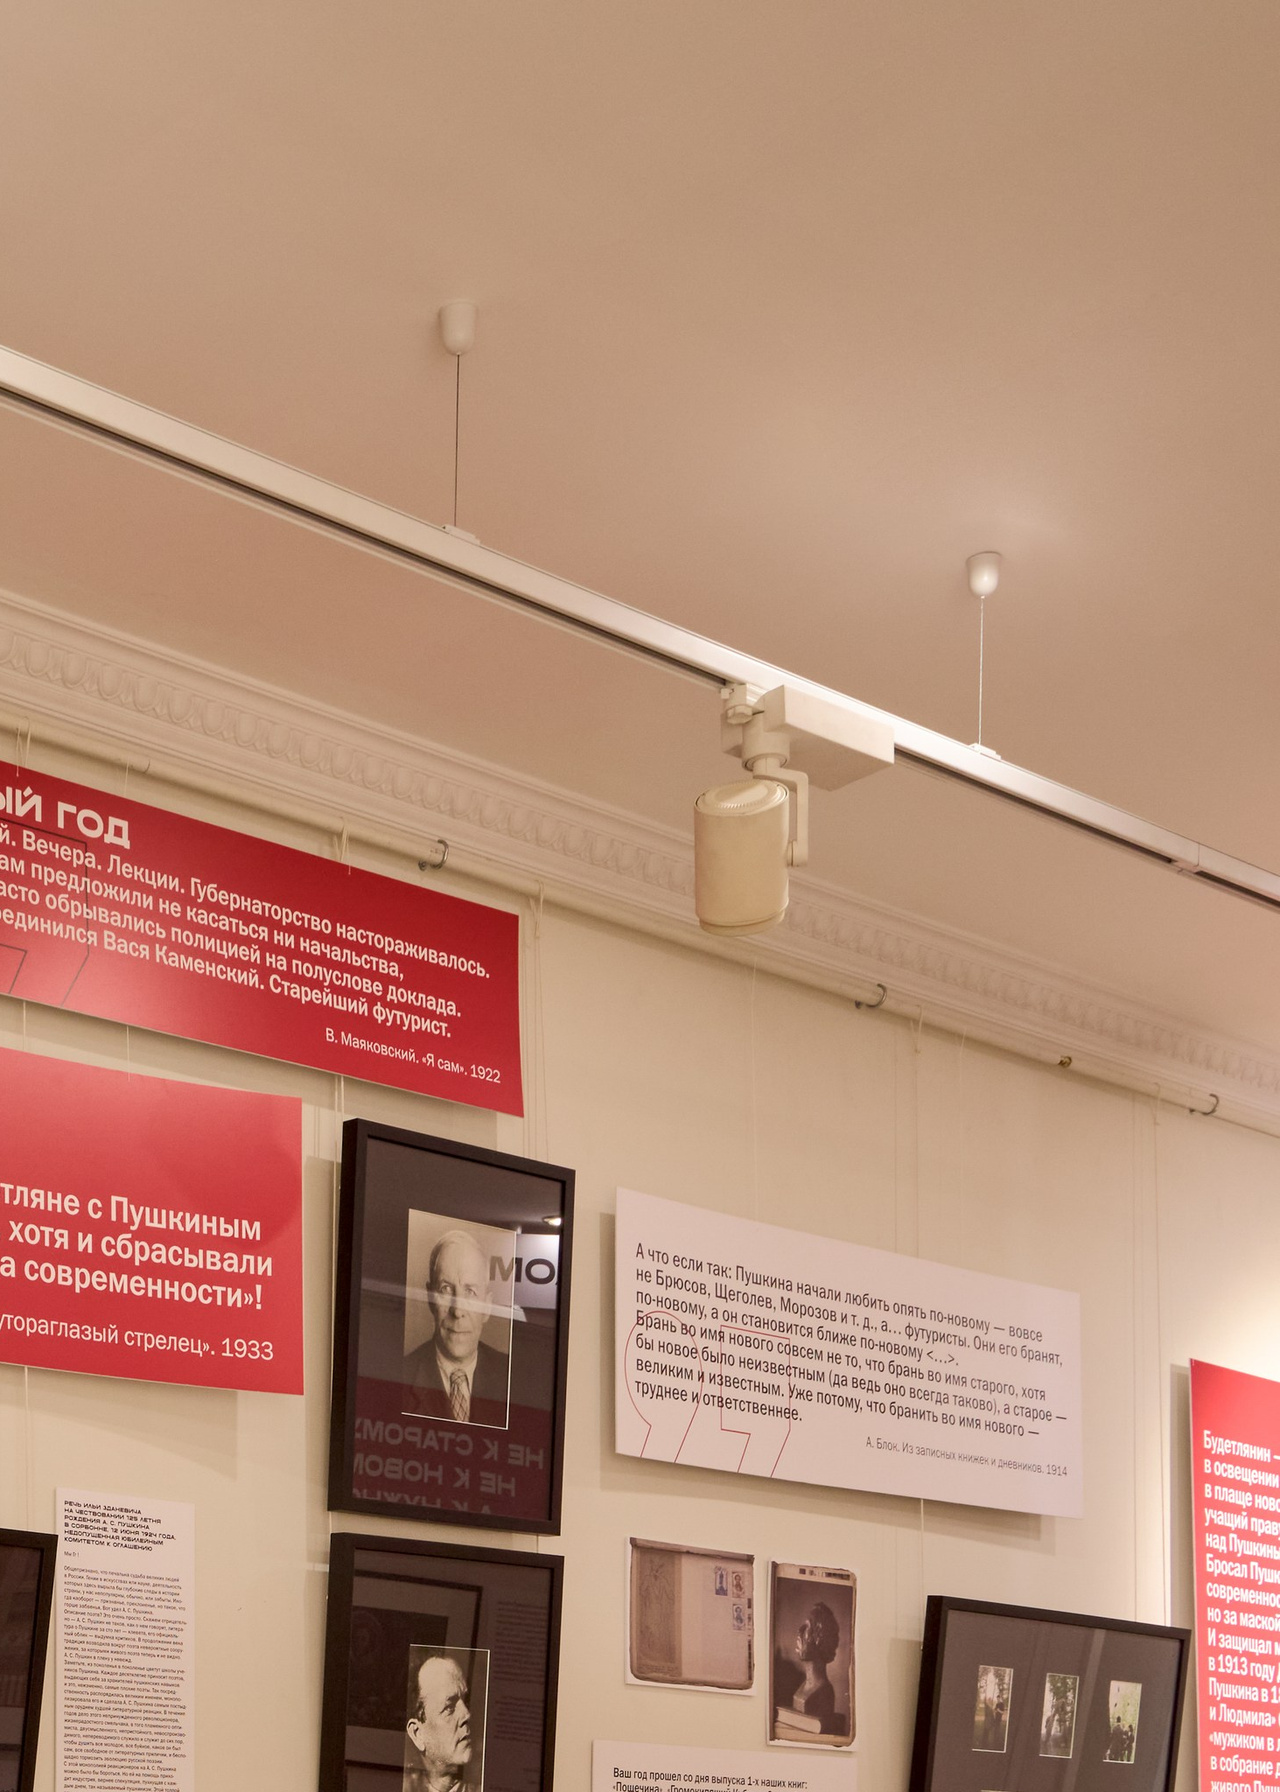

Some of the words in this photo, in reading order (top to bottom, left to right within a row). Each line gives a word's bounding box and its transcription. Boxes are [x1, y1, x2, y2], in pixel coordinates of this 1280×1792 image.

[57, 801, 131, 850] ГОД
[22, 829, 102, 871] Вечера.
[106, 853, 185, 894] Лекции.
[190, 876, 333, 935] Губернаторство
[335, 922, 490, 979] настораживалось.
[103, 929, 150, 961] Вася
[155, 943, 265, 990] Каменский.
[269, 973, 369, 1017] Старейший
[372, 1001, 452, 1038] футурист.
[87, 1197, 103, 1220] с
[110, 1194, 261, 1241] Пушкиным
[636, 1290, 708, 1321] по-новому,
[710, 1306, 719, 1321] а
[720, 1309, 741, 1330] он
[739, 1312, 814, 1339] становится
[816, 1324, 858, 1347] ближе
[859, 1336, 924, 1363] по-новому
[220, 1337, 274, 1361] 1933
[634, 1380, 688, 1402] труднее
[691, 1390, 702, 1408] и
[700, 1388, 803, 1422] ответственнее.
[1202, 1429, 1272, 1463] Будетлянин
[1207, 1656, 1216, 1672] в
[1216, 1653, 1249, 1677] 1913
[1249, 1661, 1276, 1684] году
[1208, 1705, 1217, 1722] и
